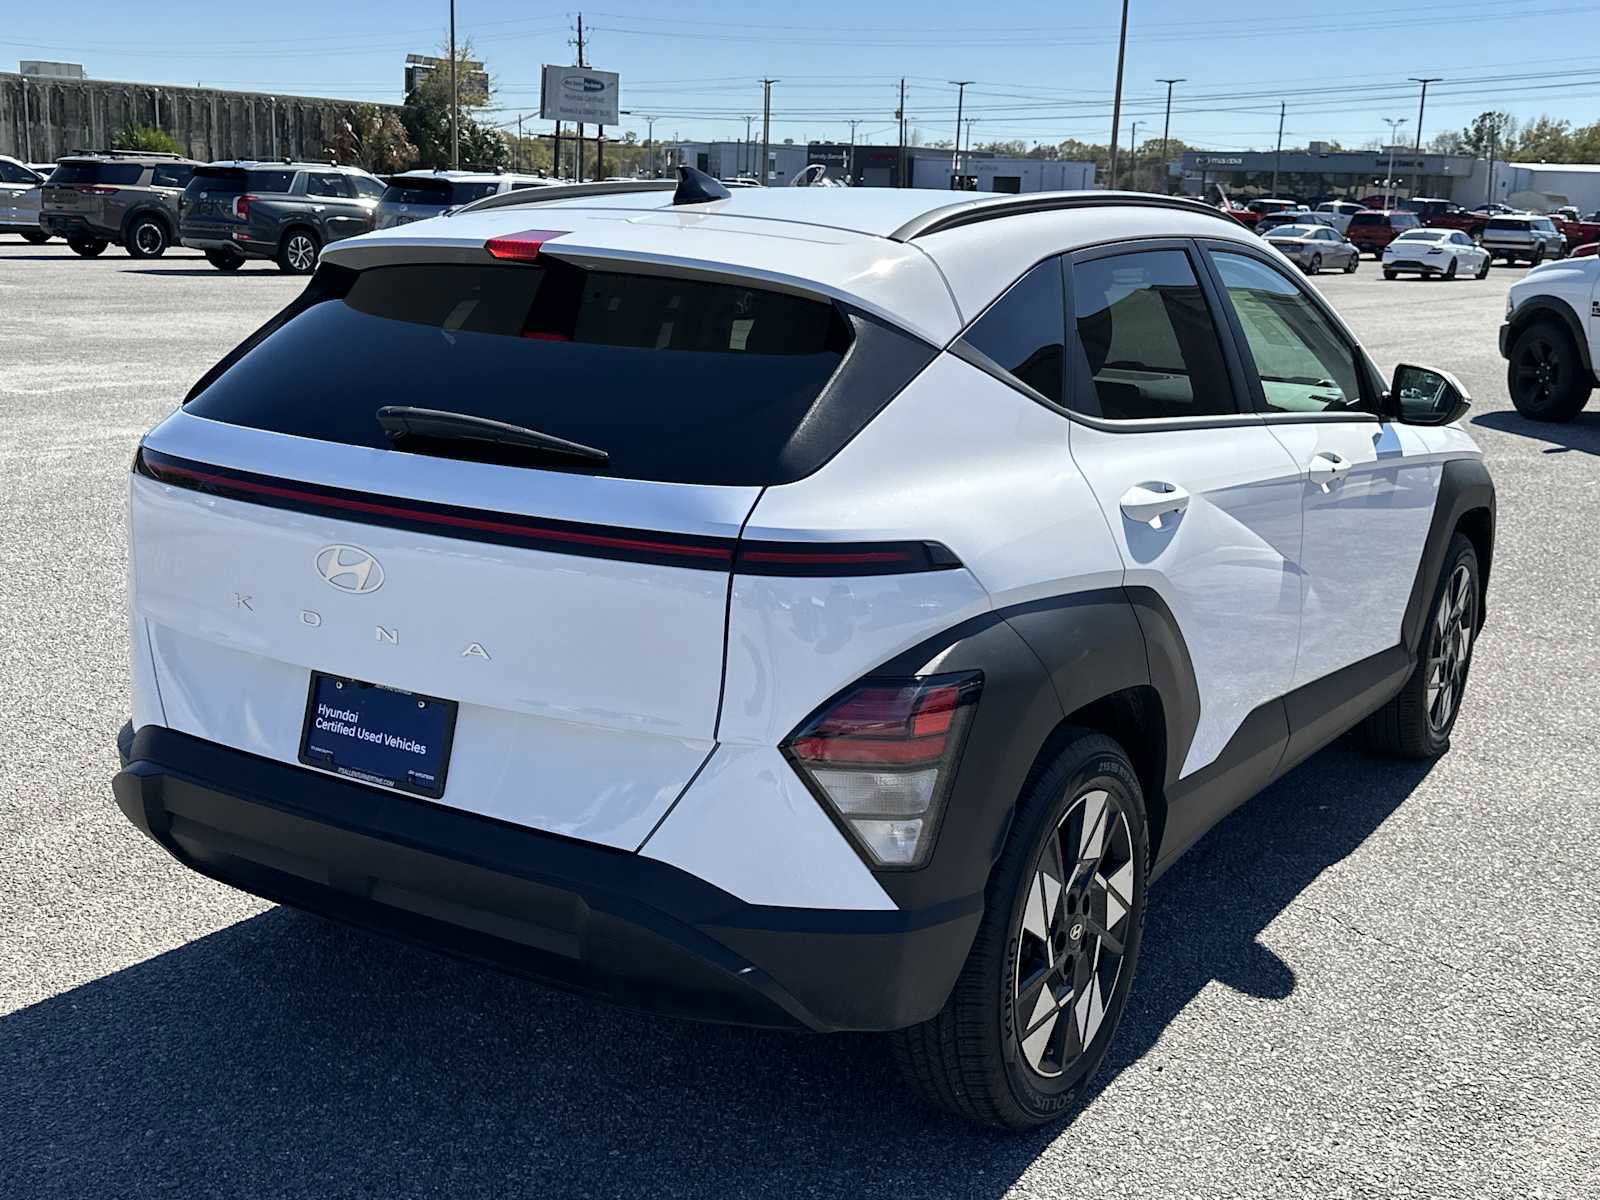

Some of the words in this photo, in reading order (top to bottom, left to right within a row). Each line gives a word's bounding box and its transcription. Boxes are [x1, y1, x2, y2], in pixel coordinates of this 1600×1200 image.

[234, 592, 492, 661] KONA
[318, 703, 360, 724] Hyundai
[315, 717, 358, 737] Certified
[357, 727, 384, 744] Used
[384, 734, 428, 755] Vehicles
[1005, 937, 1017, 1040] KUMHO
[1033, 1089, 1076, 1111] SOLUS
